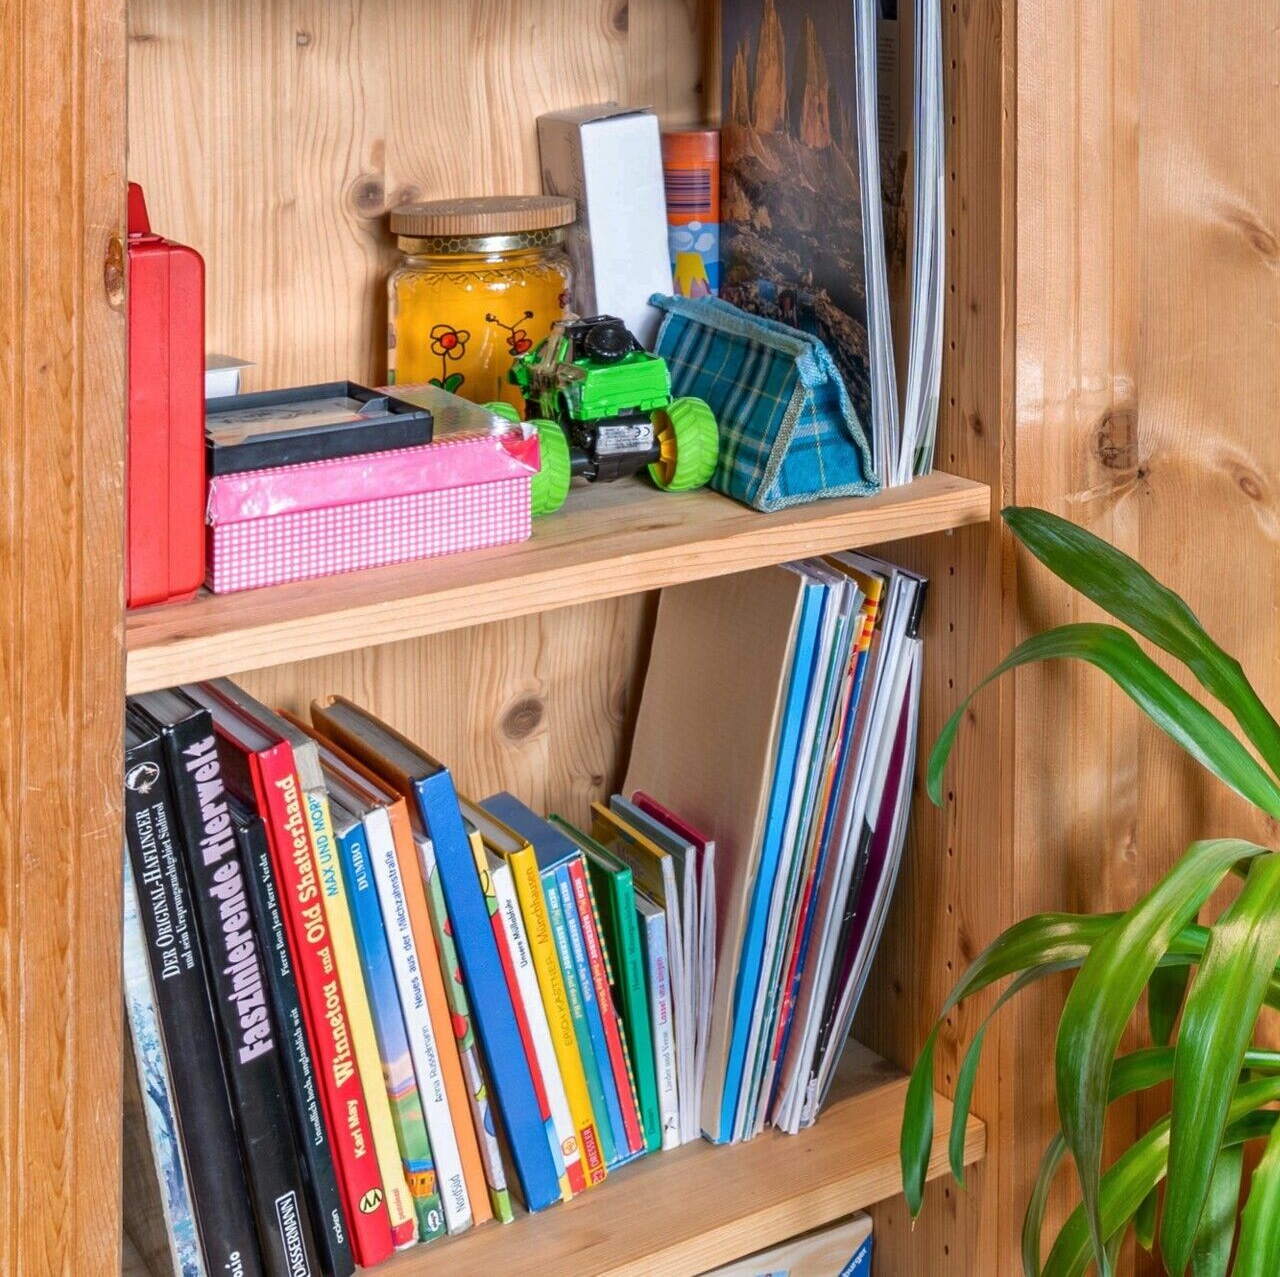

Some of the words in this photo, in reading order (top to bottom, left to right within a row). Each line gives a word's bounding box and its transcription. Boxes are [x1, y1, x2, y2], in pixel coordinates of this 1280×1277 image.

[182, 734, 235, 864] Tierwelt
[152, 801, 171, 841] Südtirol
[275, 774, 319, 903] Shatterhand
[317, 834, 333, 862] UND
[323, 867, 339, 897] MAX
[350, 842, 369, 891] DUMBO
[264, 882, 277, 909] Pierre
[301, 903, 326, 944] Old
[504, 898, 522, 940] Müllabfuhr
[180, 931, 191, 950] sein
[401, 933, 413, 952] der
[516, 941, 529, 969] Unsere
[161, 947, 181, 981] DER
[184, 950, 196, 969] und
[209, 860, 276, 1064] Faszinierende
[277, 950, 291, 976] Pierre
[316, 946, 333, 975] und
[407, 954, 417, 973] aus
[411, 975, 425, 1010] Neues
[289, 1007, 301, 1026] weit
[321, 980, 356, 1089] Winnetou
[294, 1026, 313, 1076] unglaublich
[307, 1102, 324, 1146] Unendlich
[345, 1099, 361, 1129] May
[348, 1129, 367, 1158] Karl
[583, 1127, 600, 1167] DRESSLER
